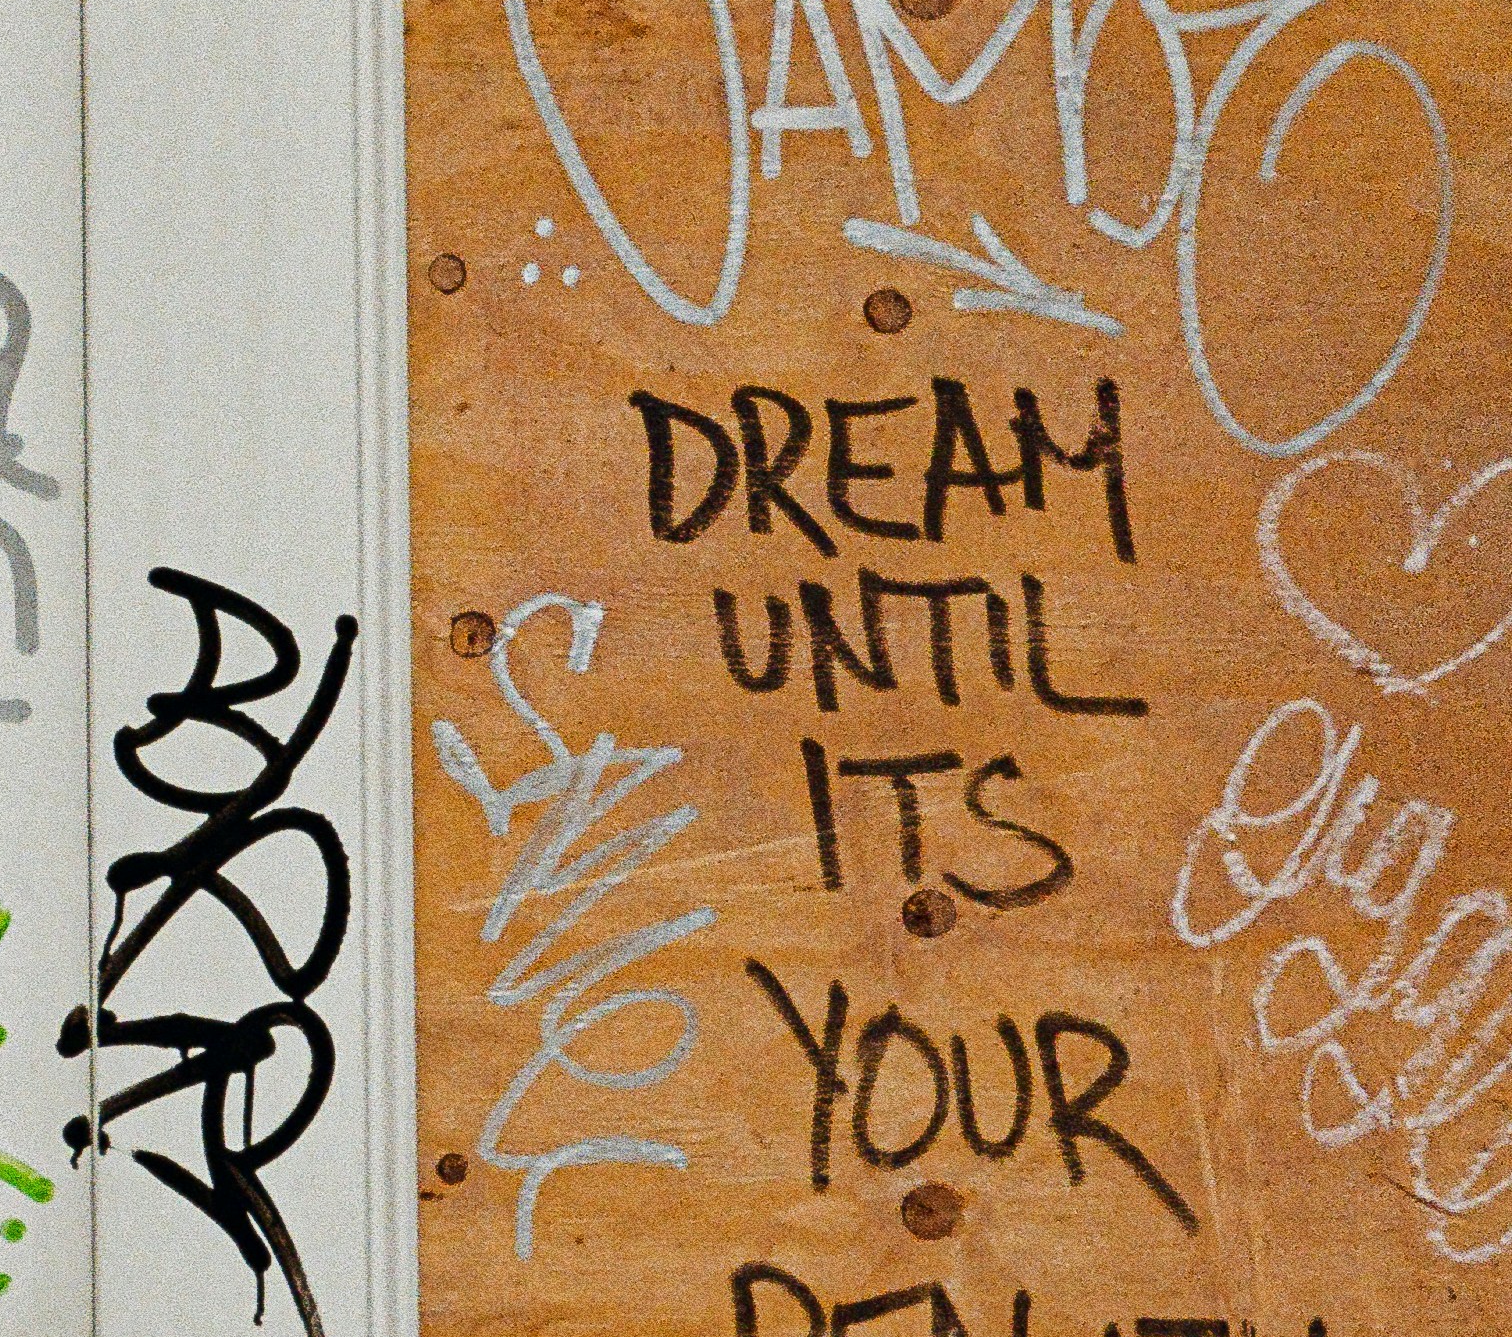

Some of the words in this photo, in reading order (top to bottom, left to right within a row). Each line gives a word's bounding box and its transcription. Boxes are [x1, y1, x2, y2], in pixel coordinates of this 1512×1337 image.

[629, 375, 1138, 563] DREAM
[712, 569, 1150, 717] UNTIL
[802, 735, 1078, 910] ITS
[744, 957, 1200, 1235] YOUR
